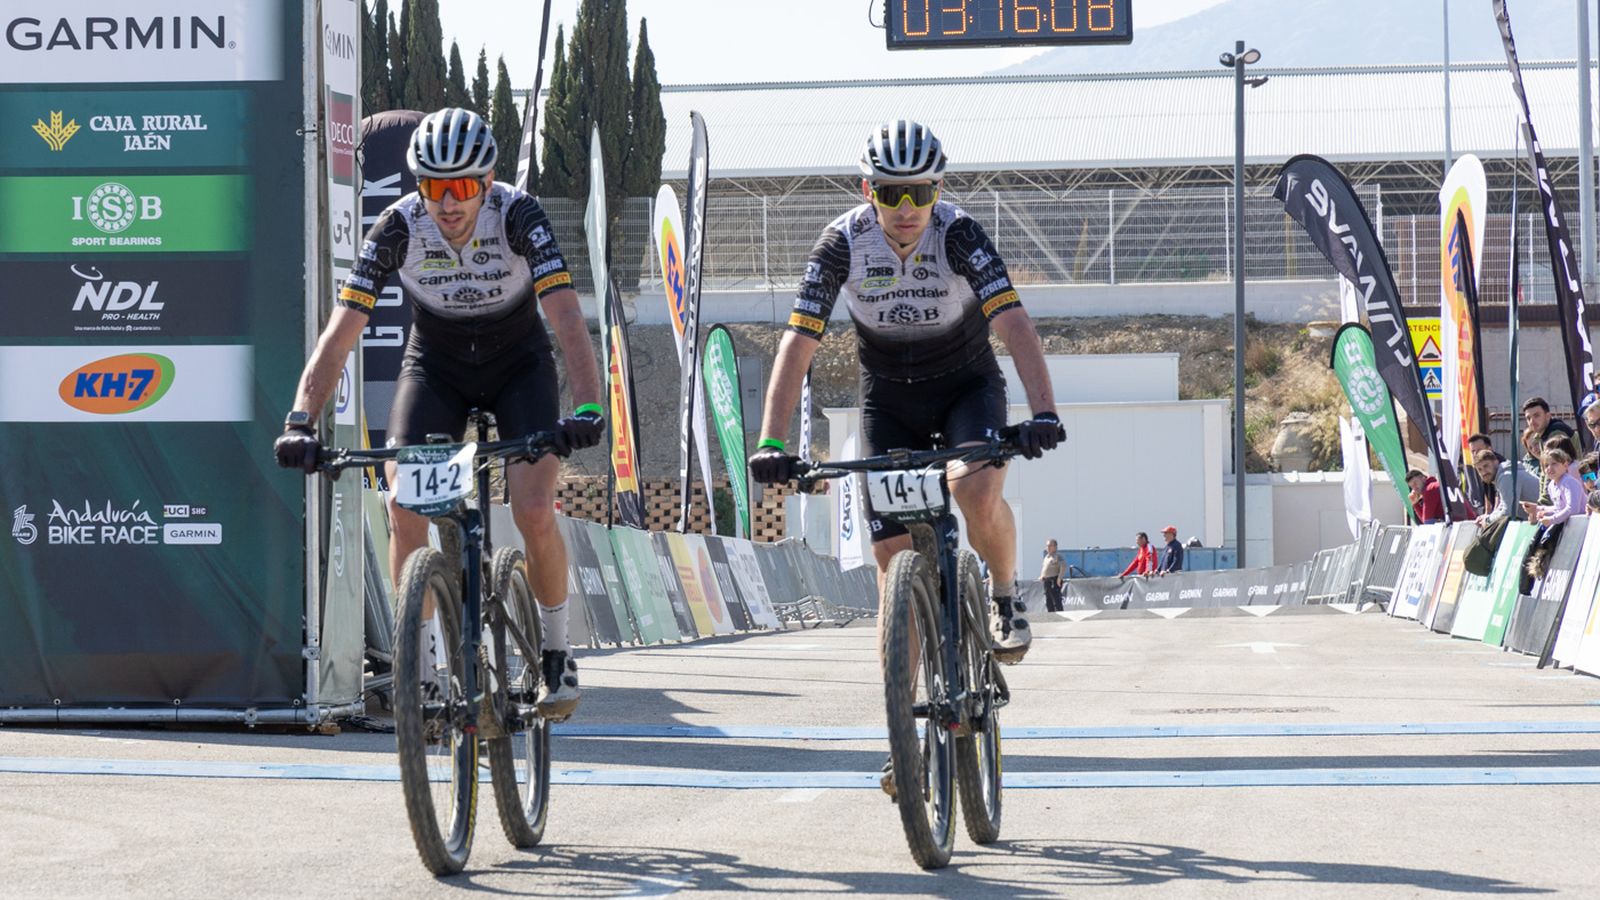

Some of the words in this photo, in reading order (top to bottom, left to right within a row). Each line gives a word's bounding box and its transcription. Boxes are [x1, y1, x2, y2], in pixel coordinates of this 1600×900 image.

[6, 15, 226, 50] GARMIN
[89, 116, 136, 131] CAJA
[142, 115, 207, 131] RURAL
[124, 133, 171, 151] JAÉN
[72, 238, 107, 246] SPORT
[110, 237, 162, 246] BEARINGS
[418, 269, 511, 286] cannondale
[72, 281, 165, 311] NDL
[857, 287, 949, 304] cannondale
[412, 463, 461, 497] 14-2
[47, 499, 157, 525] Andalucía
[168, 507, 187, 515] UCI
[49, 526, 95, 544] BIKE
[101, 526, 158, 544] RACE
[170, 529, 218, 538] GARMIN
